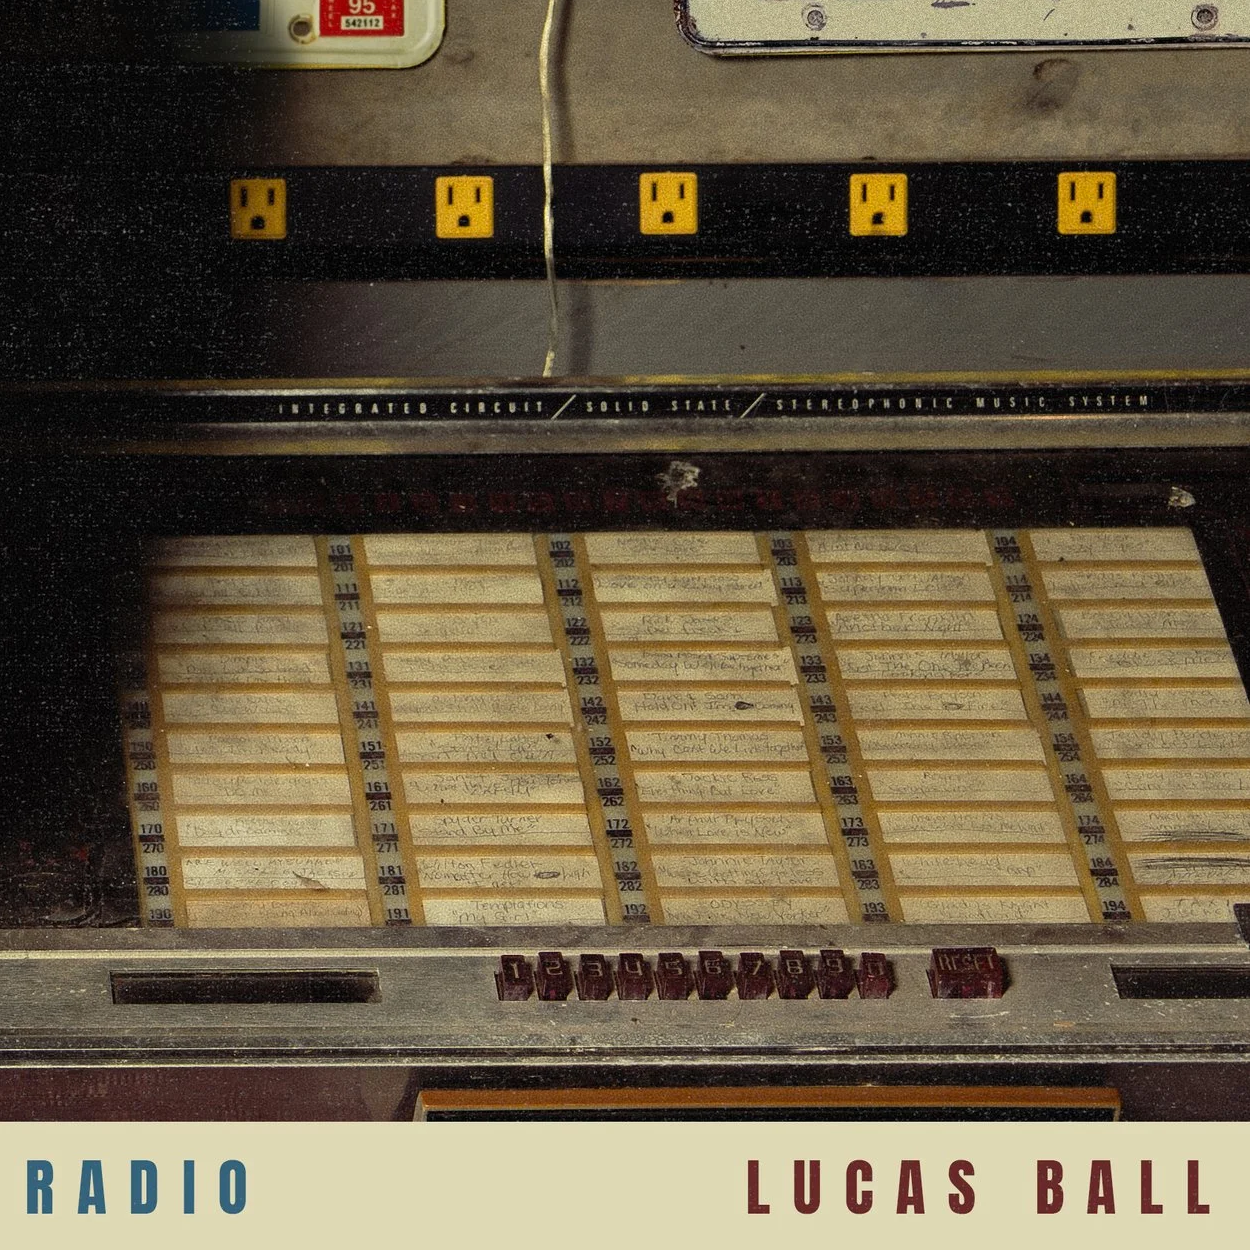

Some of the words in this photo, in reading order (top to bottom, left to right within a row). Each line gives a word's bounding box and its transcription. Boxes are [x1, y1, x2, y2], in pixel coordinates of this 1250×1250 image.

[345, 18, 380, 28] 542112
[278, 402, 427, 415] INTEGRATED
[450, 401, 543, 414] CIRCUIT
[586, 400, 649, 413] SOLID
[671, 400, 731, 412] STATE
[776, 398, 953, 411] STEREOPHONIC
[975, 397, 1045, 409] MUSIC
[1069, 395, 1148, 407] SYSTEM
[551, 541, 570, 550] 102
[777, 556, 797, 566] 203
[558, 579, 578, 589] 112
[782, 577, 802, 587] 113
[336, 584, 358, 592] 111
[562, 598, 583, 607] 212
[786, 596, 807, 605] 213
[1012, 593, 1032, 602] 214
[339, 602, 360, 610] 211
[566, 618, 587, 627] 122
[1018, 614, 1039, 624] 124
[345, 640, 365, 650] 221
[570, 636, 590, 646] 222
[574, 658, 594, 667] 132
[800, 656, 821, 666] 133
[1030, 654, 1050, 663] 134
[348, 662, 369, 671] 131
[578, 676, 599, 685] 232
[805, 674, 826, 684] 233
[1035, 672, 1056, 682] 234
[582, 697, 603, 706] 142
[810, 695, 832, 704] 143
[354, 702, 375, 710] 141
[586, 715, 607, 725] 242
[815, 714, 836, 724] 243
[590, 738, 611, 747] 152
[821, 735, 842, 745] 153
[360, 741, 382, 750] 151
[594, 756, 616, 766] 252
[826, 754, 848, 764] 253
[1060, 752, 1080, 762] 254
[598, 778, 620, 788] 162
[831, 776, 852, 786] 163
[1065, 774, 1087, 784] 164
[366, 782, 388, 792] 161
[370, 801, 392, 811] 261
[602, 797, 624, 807] 262
[606, 819, 629, 829] 172
[842, 818, 864, 828] 173
[1078, 816, 1100, 826] 174
[140, 824, 162, 834] 170
[373, 823, 395, 833] 171
[611, 838, 633, 848] 272
[847, 837, 869, 847] 273
[1084, 834, 1105, 844] 274
[143, 843, 164, 853] 270
[377, 843, 398, 852] 271
[615, 862, 638, 872] 182
[1090, 858, 1113, 868] 184
[145, 866, 167, 876] 180
[380, 866, 401, 876] 181
[620, 881, 642, 892] 282
[1096, 878, 1119, 888] 284
[384, 885, 405, 896] 281
[624, 904, 647, 915] 192
[863, 902, 885, 913] 193
[1103, 900, 1126, 911] 194
[387, 908, 409, 919] 191
[508, 963, 521, 979] 1
[544, 960, 562, 976] 2
[585, 961, 603, 978] 3
[624, 960, 643, 977] 4
[664, 960, 683, 976] 5
[705, 959, 722, 976] 6
[746, 959, 764, 977] 7
[786, 958, 802, 976] 8
[826, 957, 844, 974] 9
[939, 953, 996, 971] RESET
